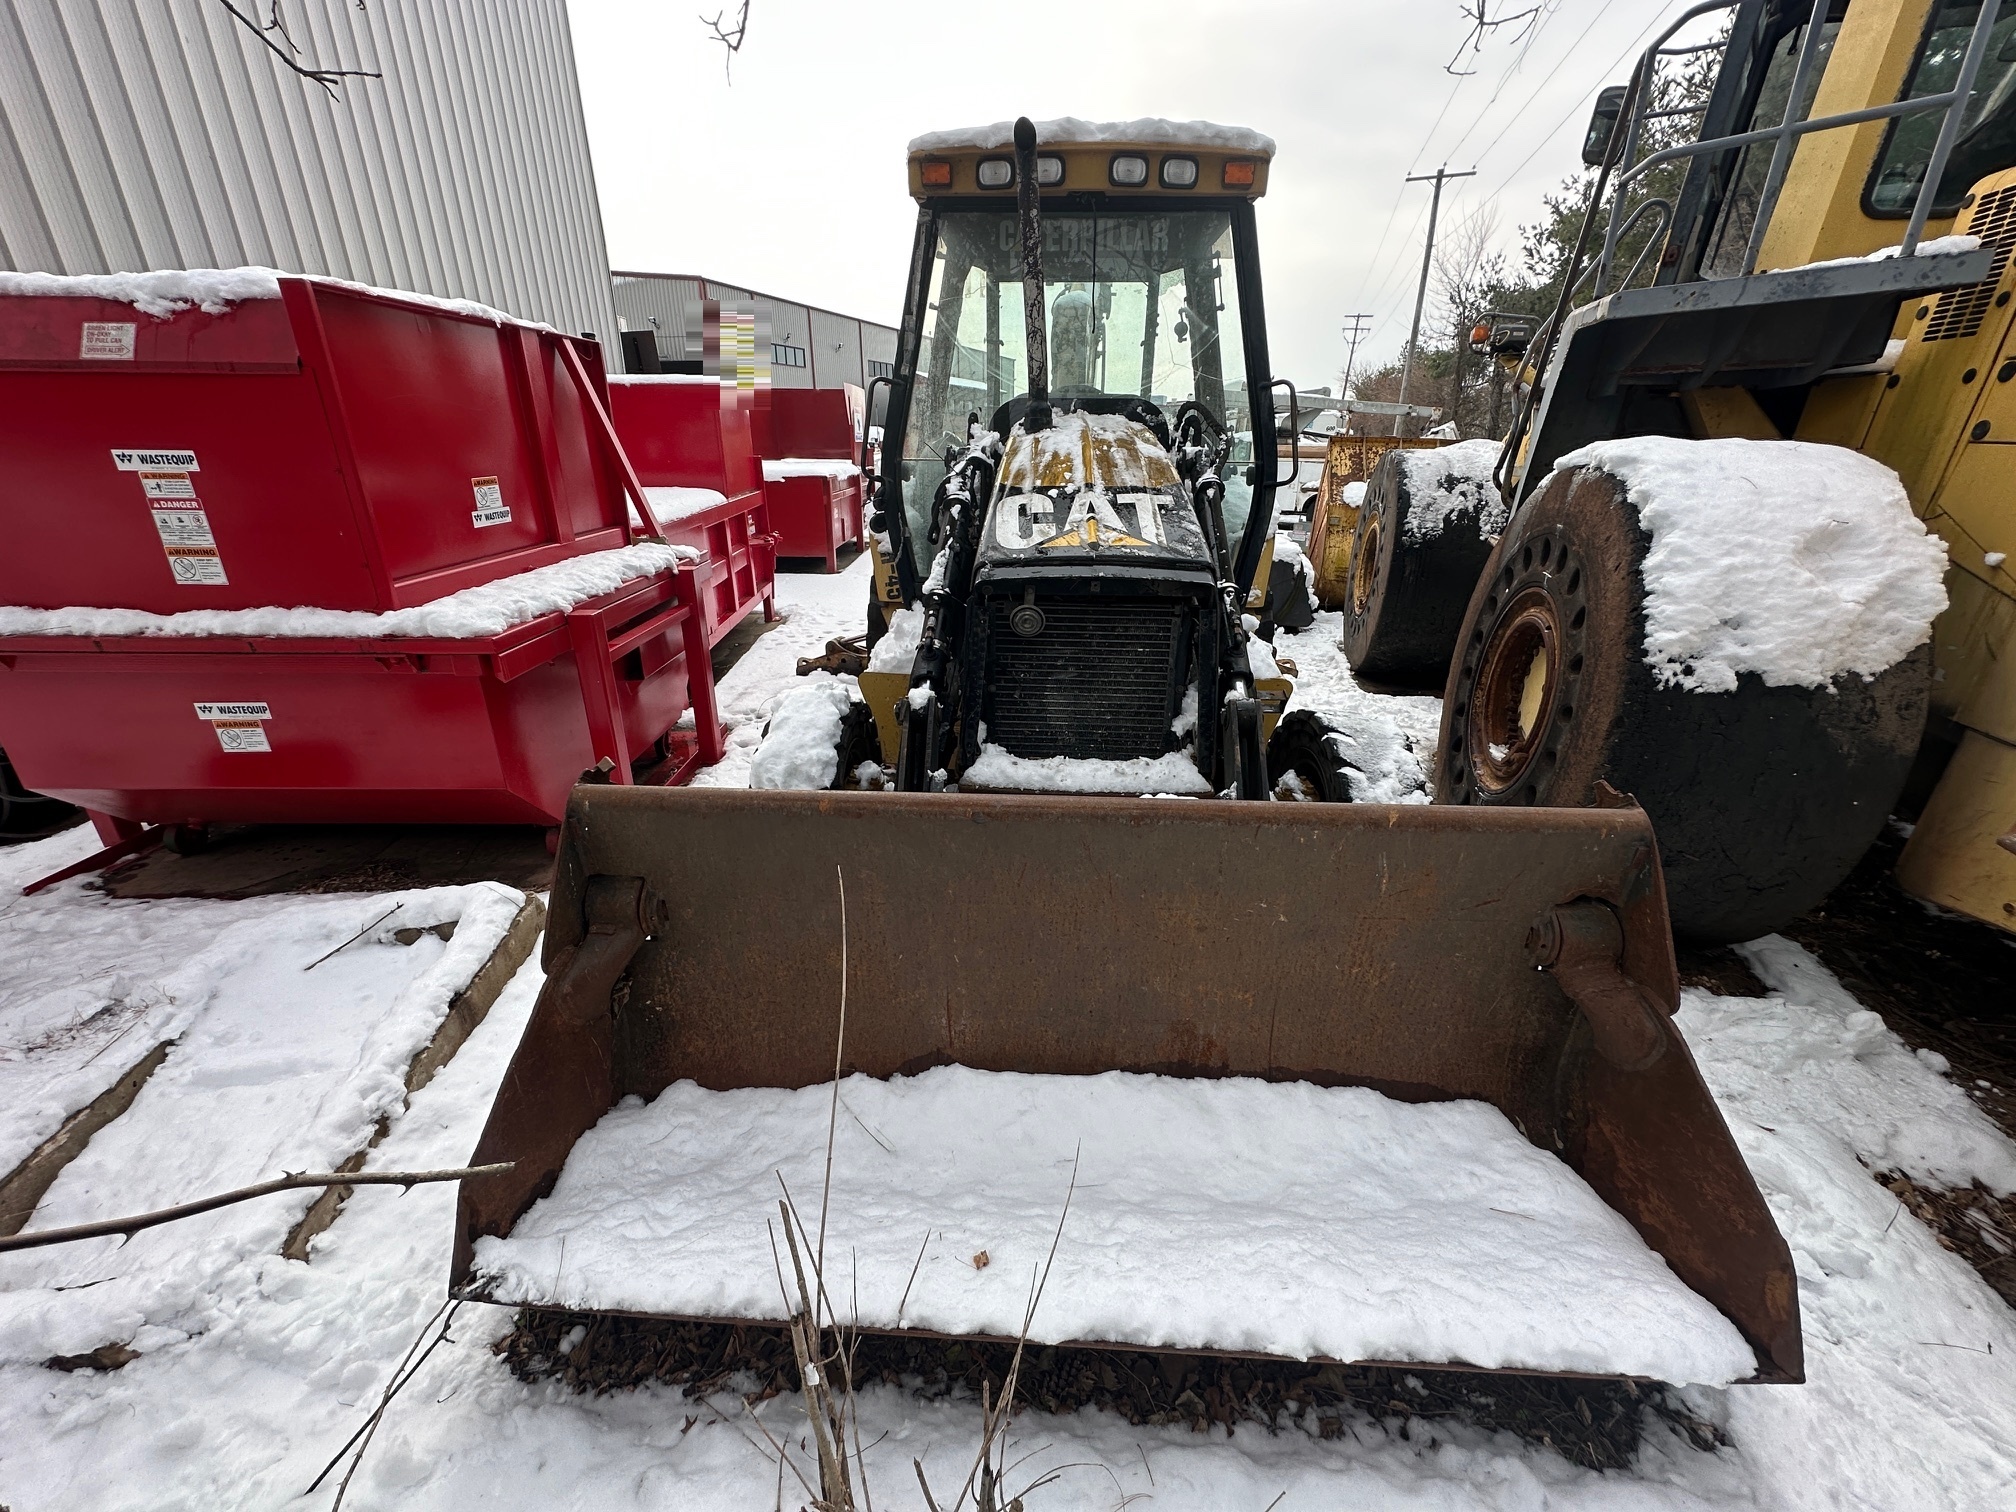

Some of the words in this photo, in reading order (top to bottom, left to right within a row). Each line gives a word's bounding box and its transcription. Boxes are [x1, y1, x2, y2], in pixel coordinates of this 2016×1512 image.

[999, 217, 1169, 252] CERPILLAR
[137, 454, 195, 465] WASTEQUIP
[484, 510, 509, 521] WASTEQUIP
[995, 492, 1175, 550] CAT
[173, 548, 216, 556] WARNING
[217, 706, 268, 714] WASTEQUIP
